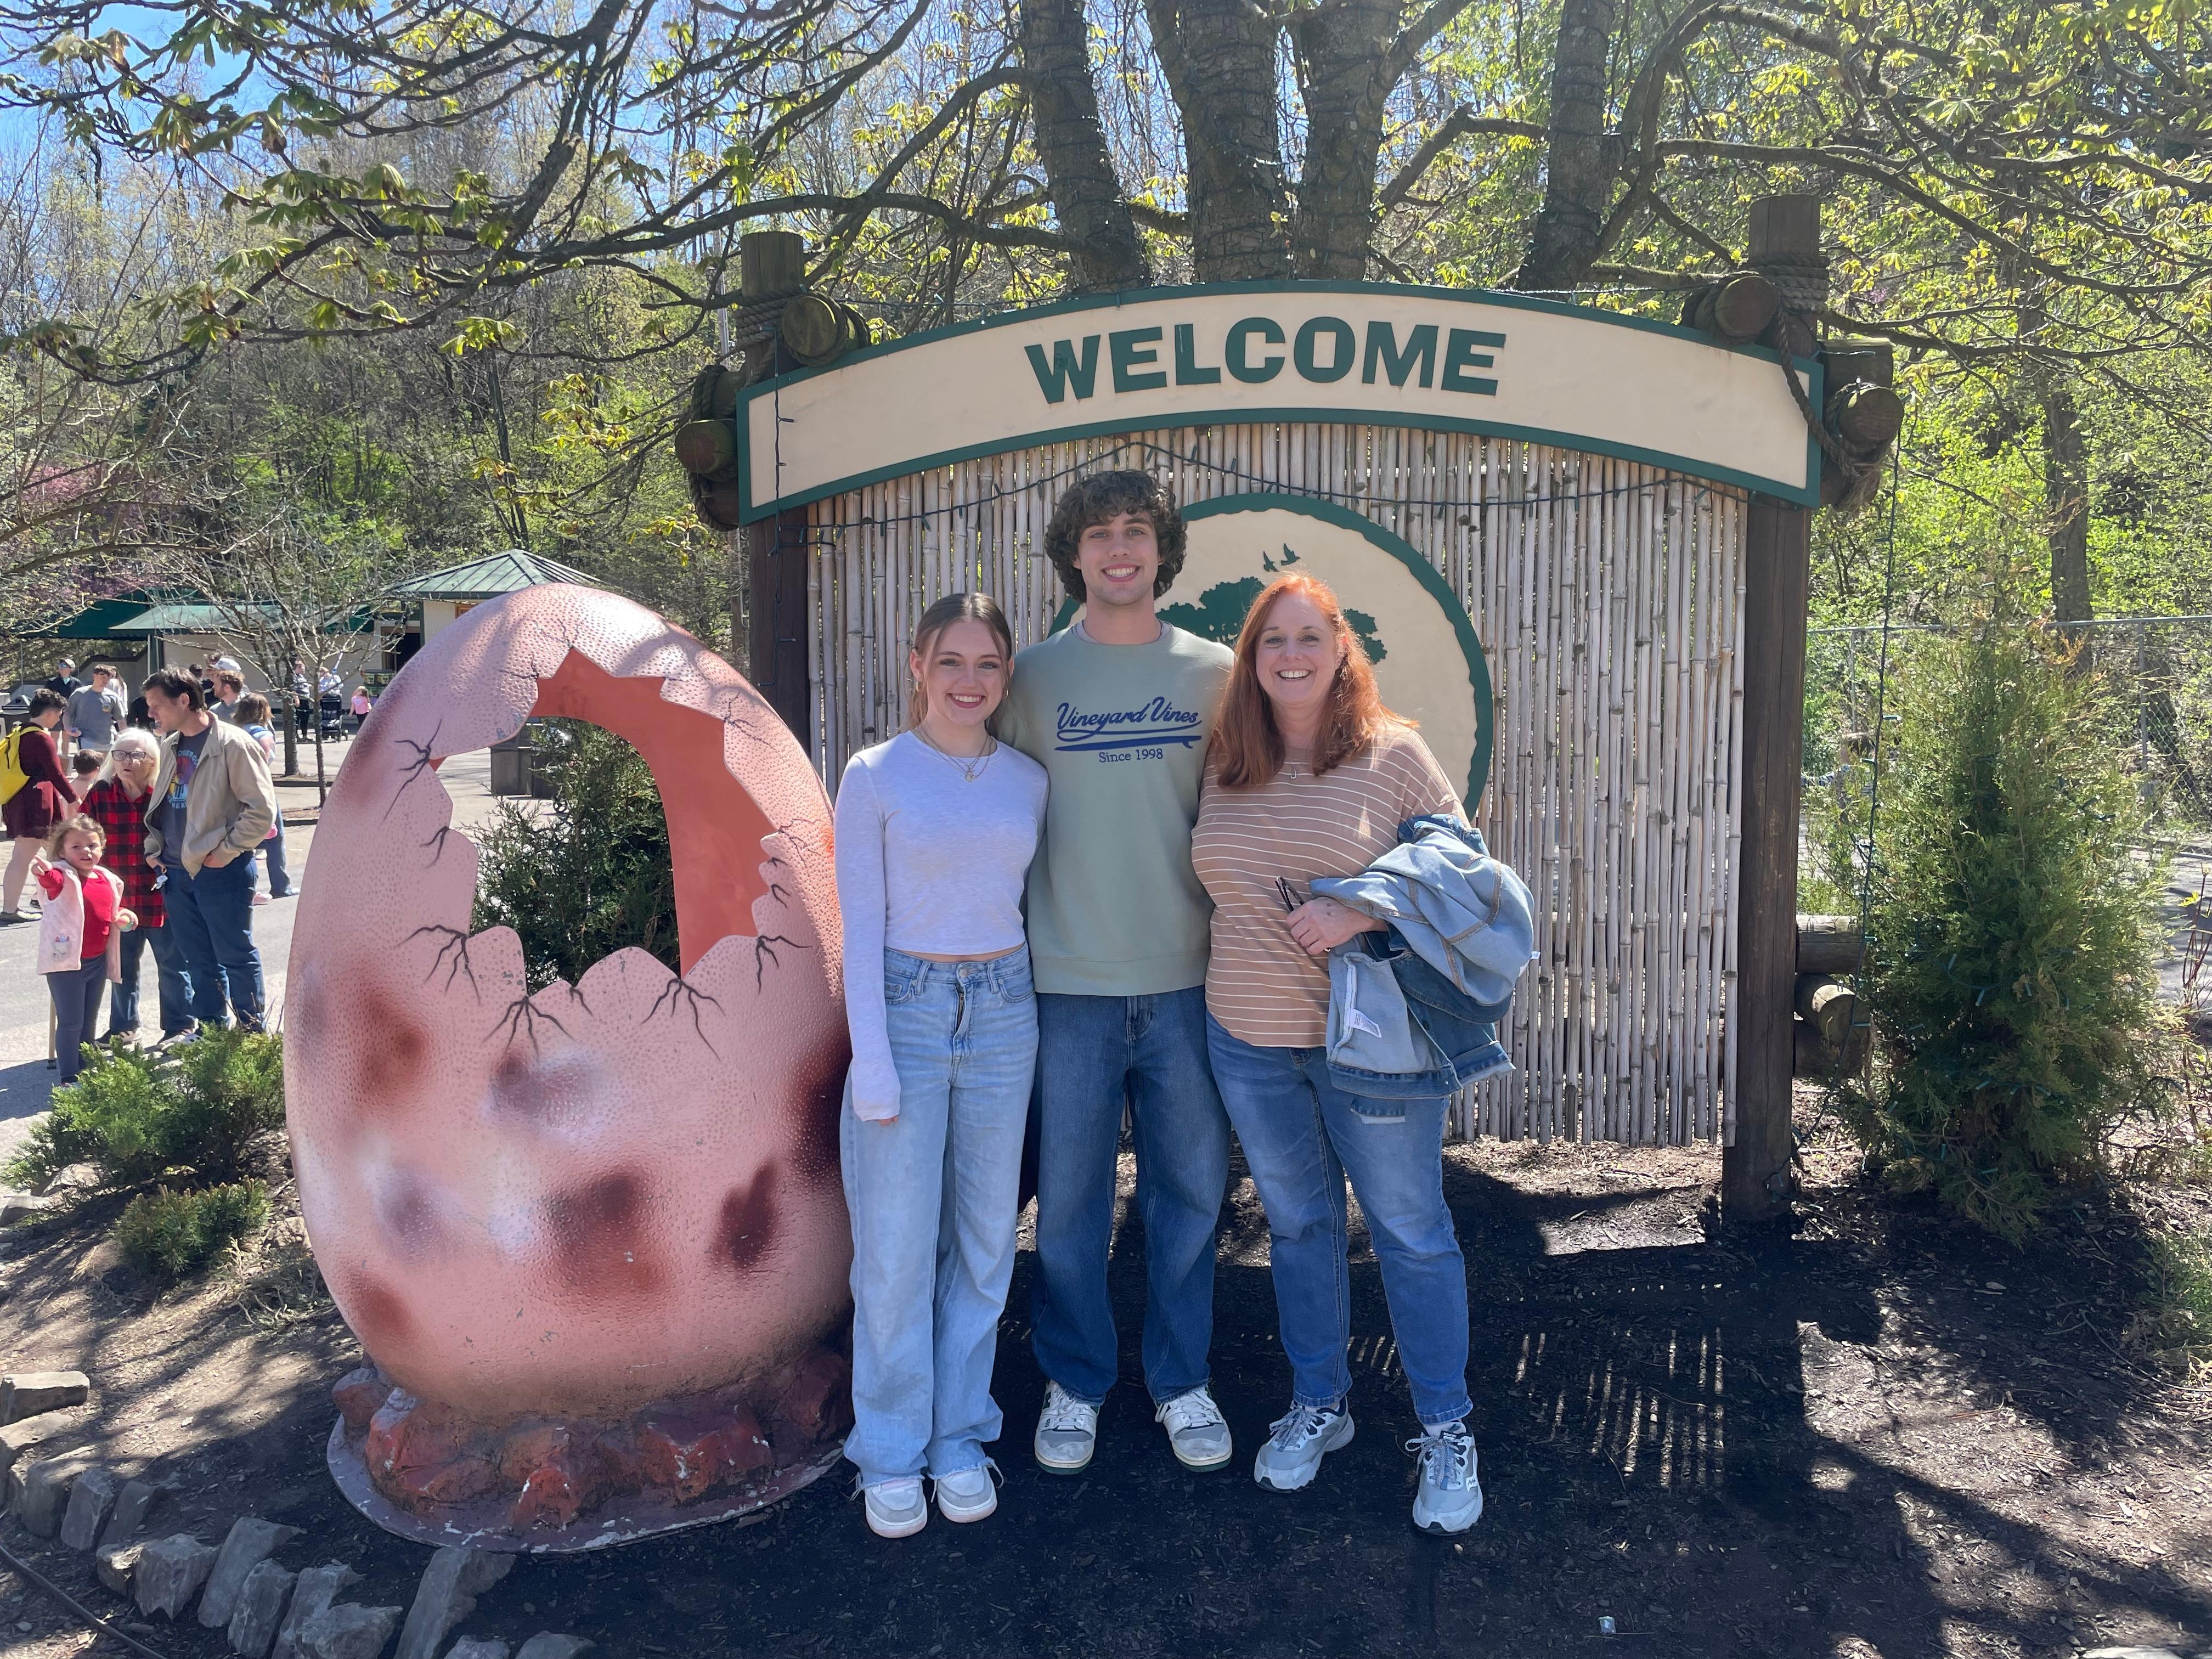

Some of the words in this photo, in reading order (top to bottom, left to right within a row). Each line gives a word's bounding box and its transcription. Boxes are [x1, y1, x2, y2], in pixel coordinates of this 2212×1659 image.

[1024, 316, 1506, 404] WELCOME
[1056, 702, 1152, 737] Vineyard
[1152, 696, 1200, 724] Vines
[1098, 751, 1131, 763] Since
[1136, 748, 1164, 760] 1998
